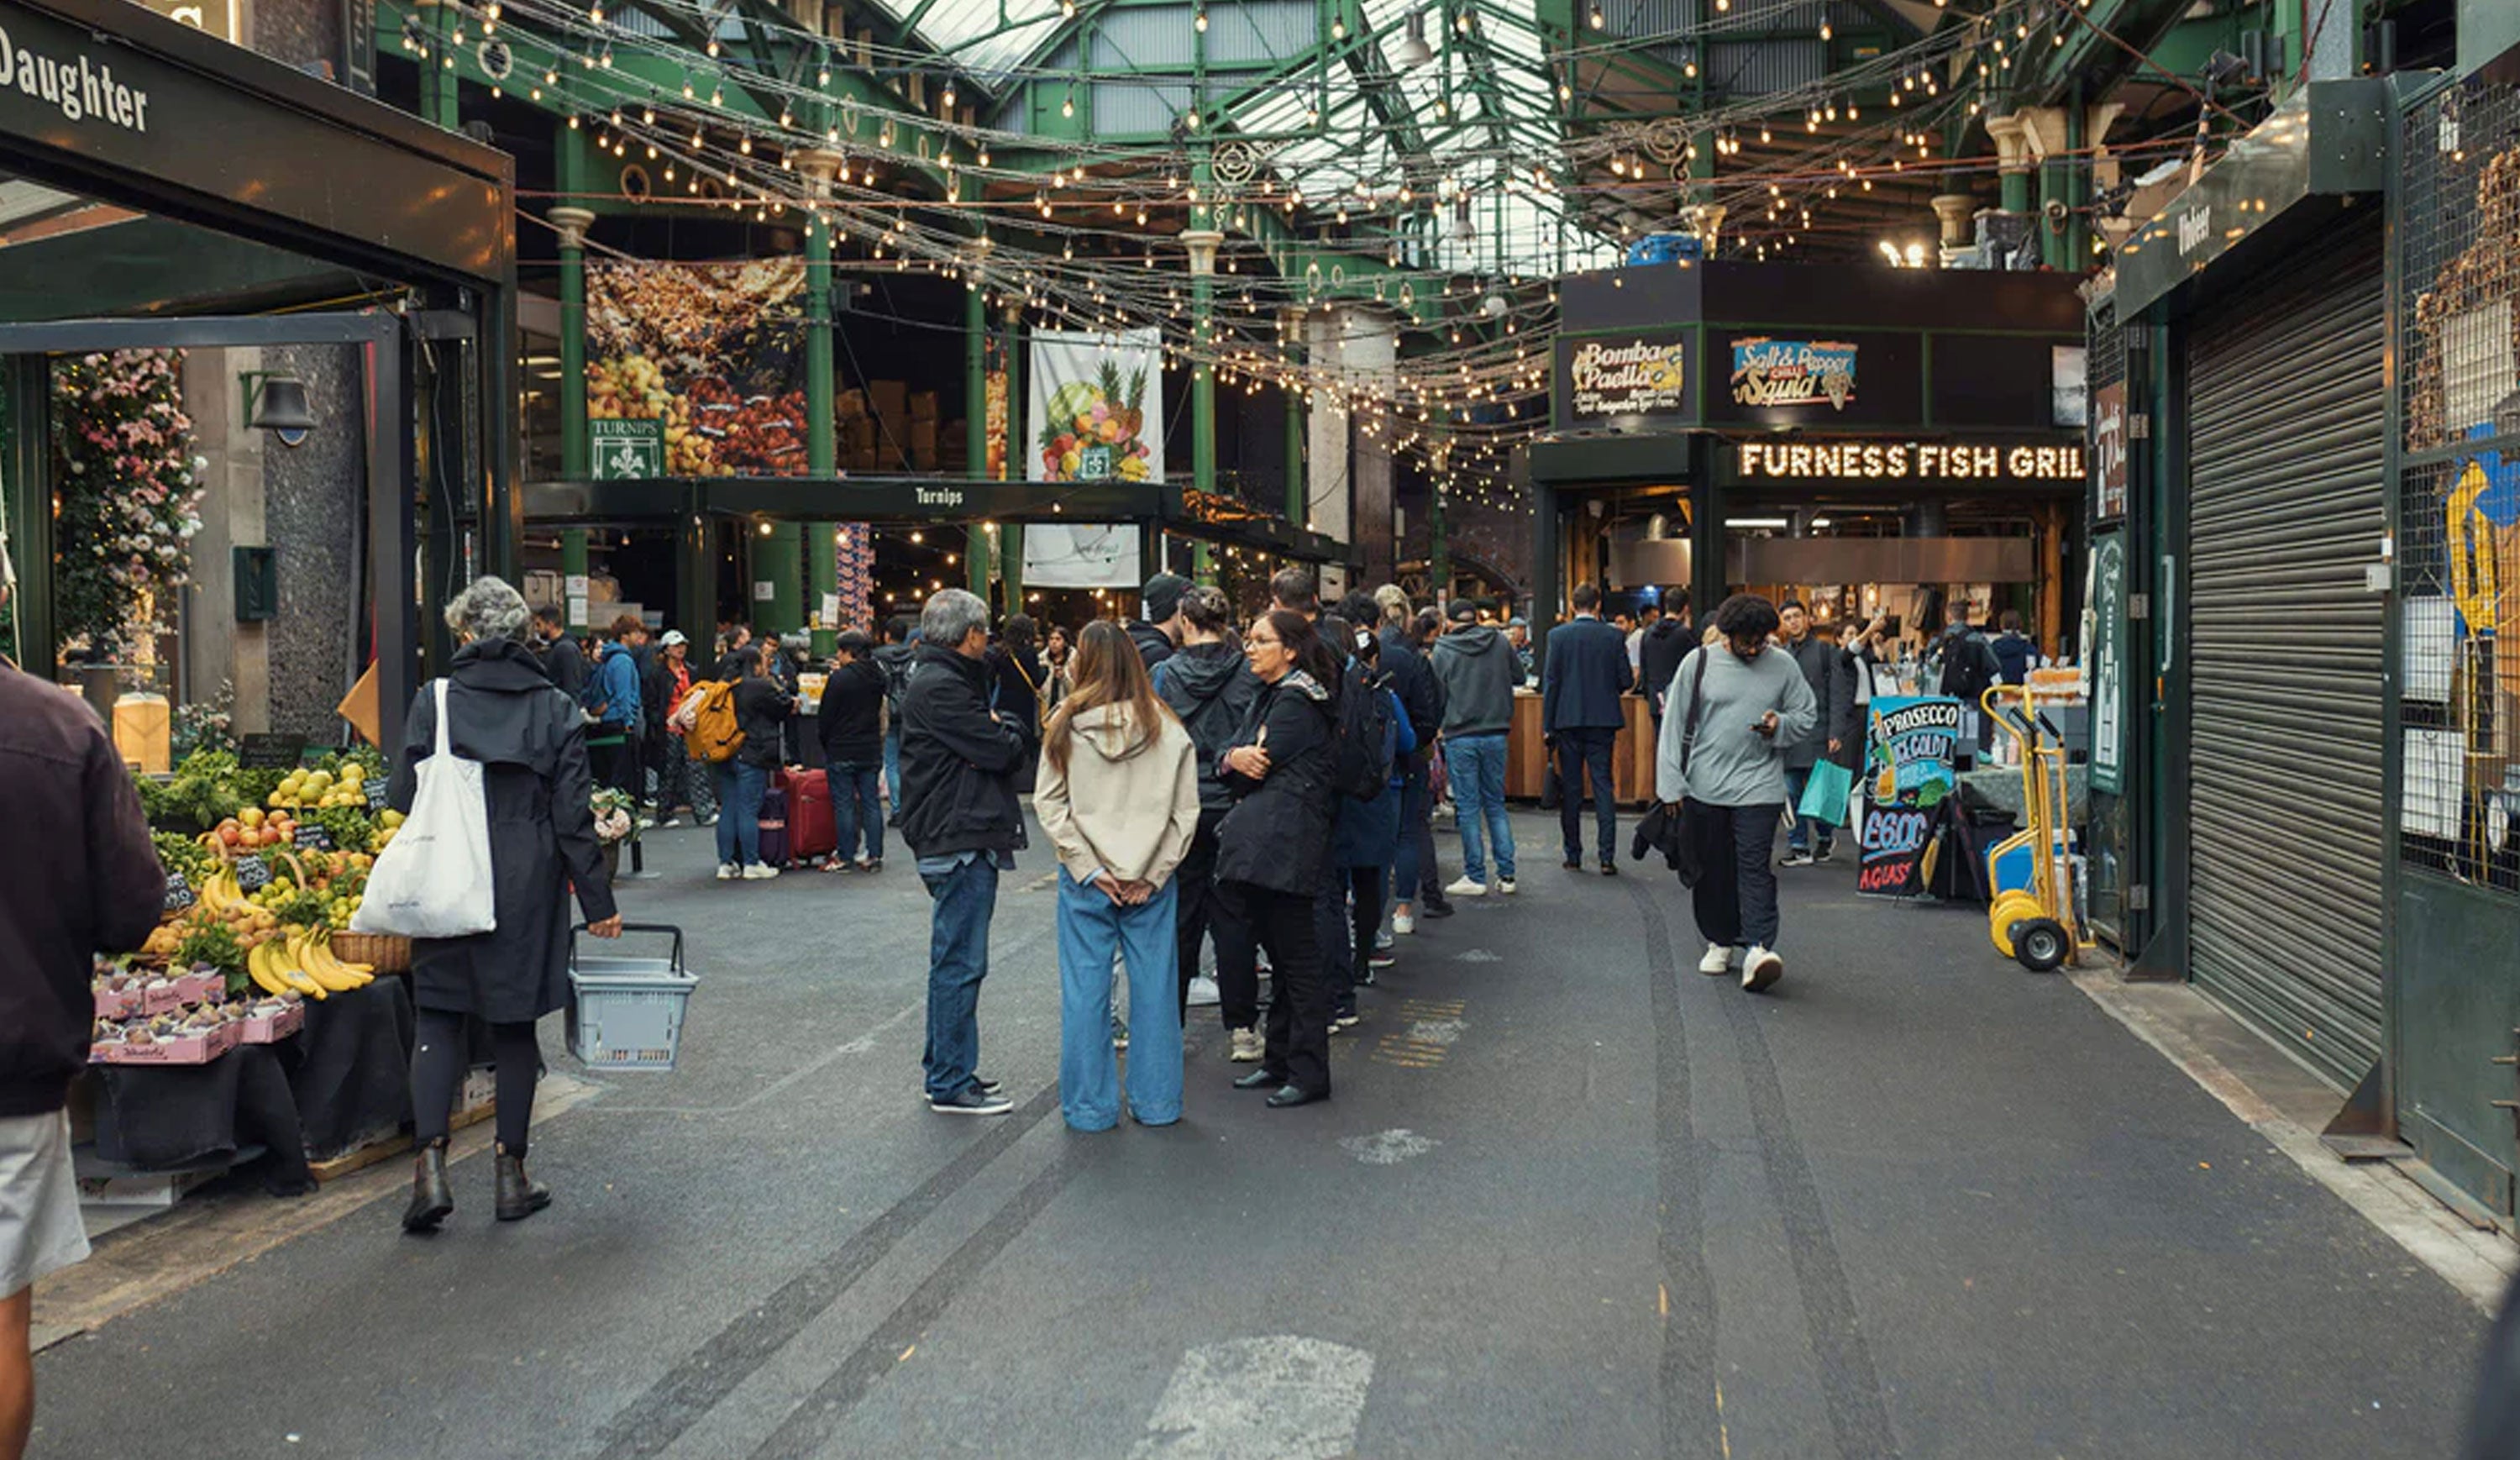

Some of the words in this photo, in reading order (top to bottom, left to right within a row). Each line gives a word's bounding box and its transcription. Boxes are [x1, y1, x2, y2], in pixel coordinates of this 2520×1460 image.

[0, 26, 147, 132] Daughter
[1585, 339, 1662, 366] Bomba
[1742, 345, 1780, 370] Salt
[1778, 346, 1794, 367] &
[1798, 347, 1850, 373] Pepper
[1583, 365, 1651, 390] Paella
[1732, 367, 1817, 407] Squid
[1740, 444, 1908, 477] FURNESS
[1919, 447, 1998, 477] FISH
[915, 487, 963, 507] Turnips
[1883, 705, 1958, 736] PROSECCO
[1870, 860, 1914, 889] GLASS
